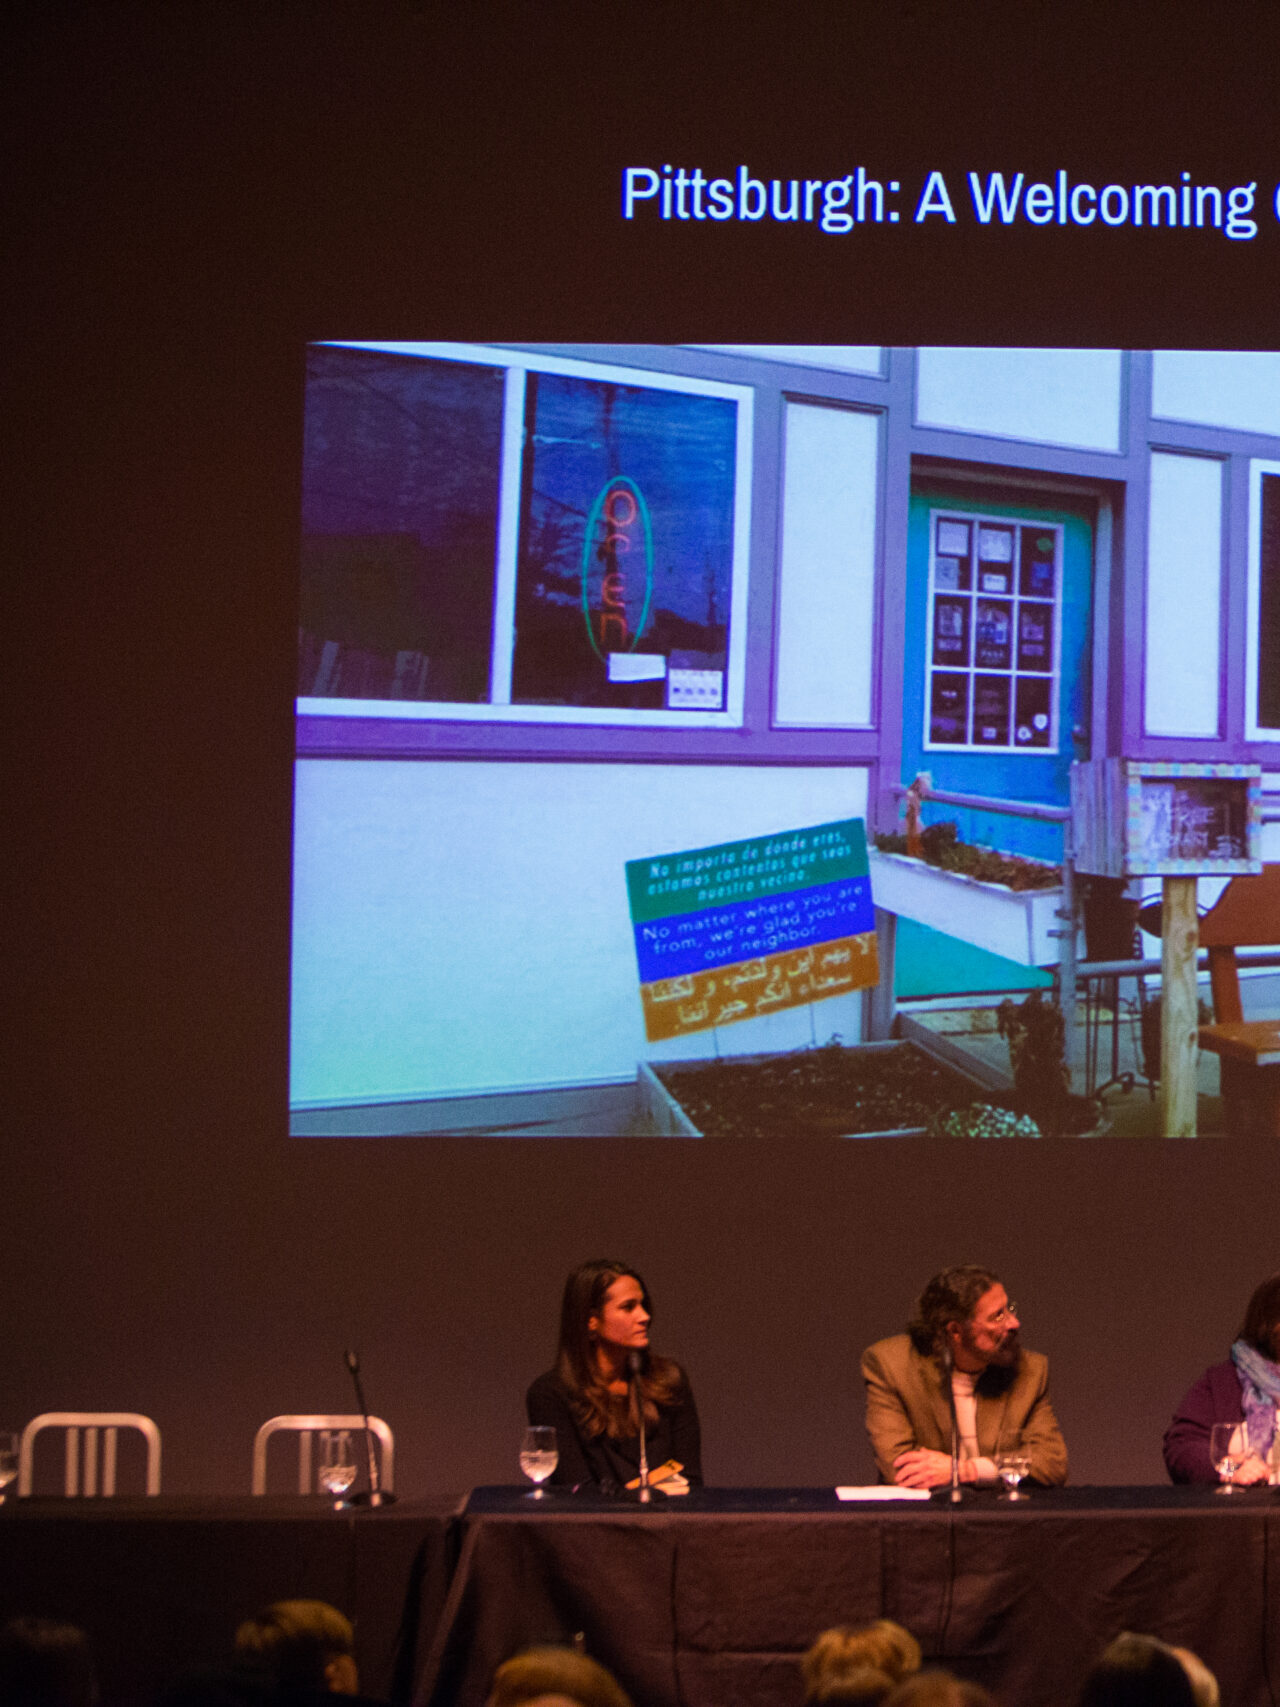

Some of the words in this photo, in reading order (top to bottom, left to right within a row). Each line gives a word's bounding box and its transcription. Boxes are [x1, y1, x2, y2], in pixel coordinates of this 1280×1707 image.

[622, 164, 900, 234] Pittsburgh:
[914, 171, 956, 223] A
[966, 169, 1258, 240] Welcoming
[648, 874, 710, 895] estamos
[716, 857, 785, 883] contentos
[792, 851, 816, 870] que
[822, 845, 851, 860] seas
[650, 862, 670, 878] No
[676, 851, 736, 874] importa
[742, 844, 759, 861] de
[642, 925, 670, 940] No
[678, 912, 736, 934] matter
[746, 898, 796, 919] where
[803, 891, 832, 910] you
[840, 885, 863, 899] are
[698, 880, 754, 901] nuestro
[653, 936, 703, 955] from,
[710, 923, 756, 943] we're
[763, 913, 801, 937] glad
[807, 901, 857, 925] you're
[704, 943, 733, 960] our
[741, 925, 821, 949] neighbor.
